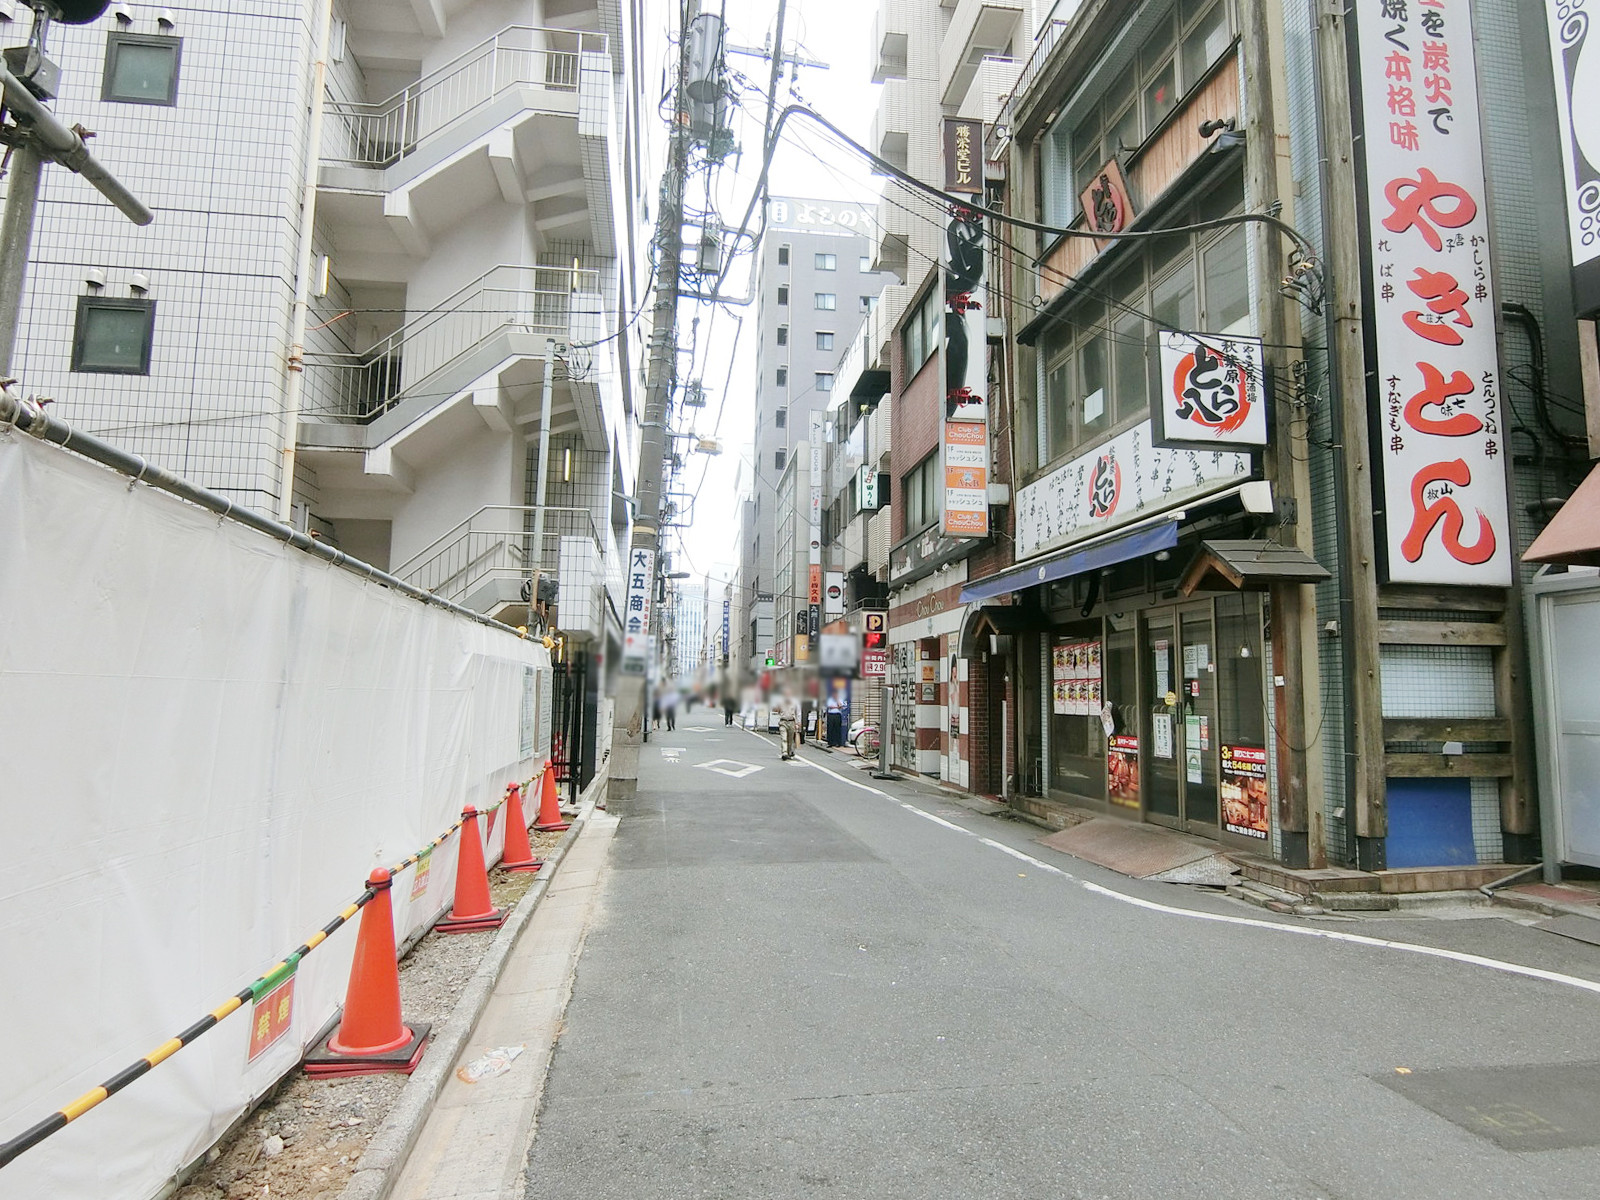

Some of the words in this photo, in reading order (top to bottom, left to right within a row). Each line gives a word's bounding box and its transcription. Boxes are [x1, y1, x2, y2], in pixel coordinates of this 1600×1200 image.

[1418, 0, 1453, 135] を炭火で
[1377, 238, 1395, 303] れば串
[1469, 234, 1488, 303] かしら串
[1221, 340, 1241, 384] 秋葉原
[1381, 167, 1497, 565] やきとん
[948, 432, 984, 440] ChouChou
[1385, 374, 1405, 456] すなぎも串
[1481, 370, 1498, 460] とんつくね串
[868, 615, 882, 630] P
[1221, 746, 1233, 760] 3F
